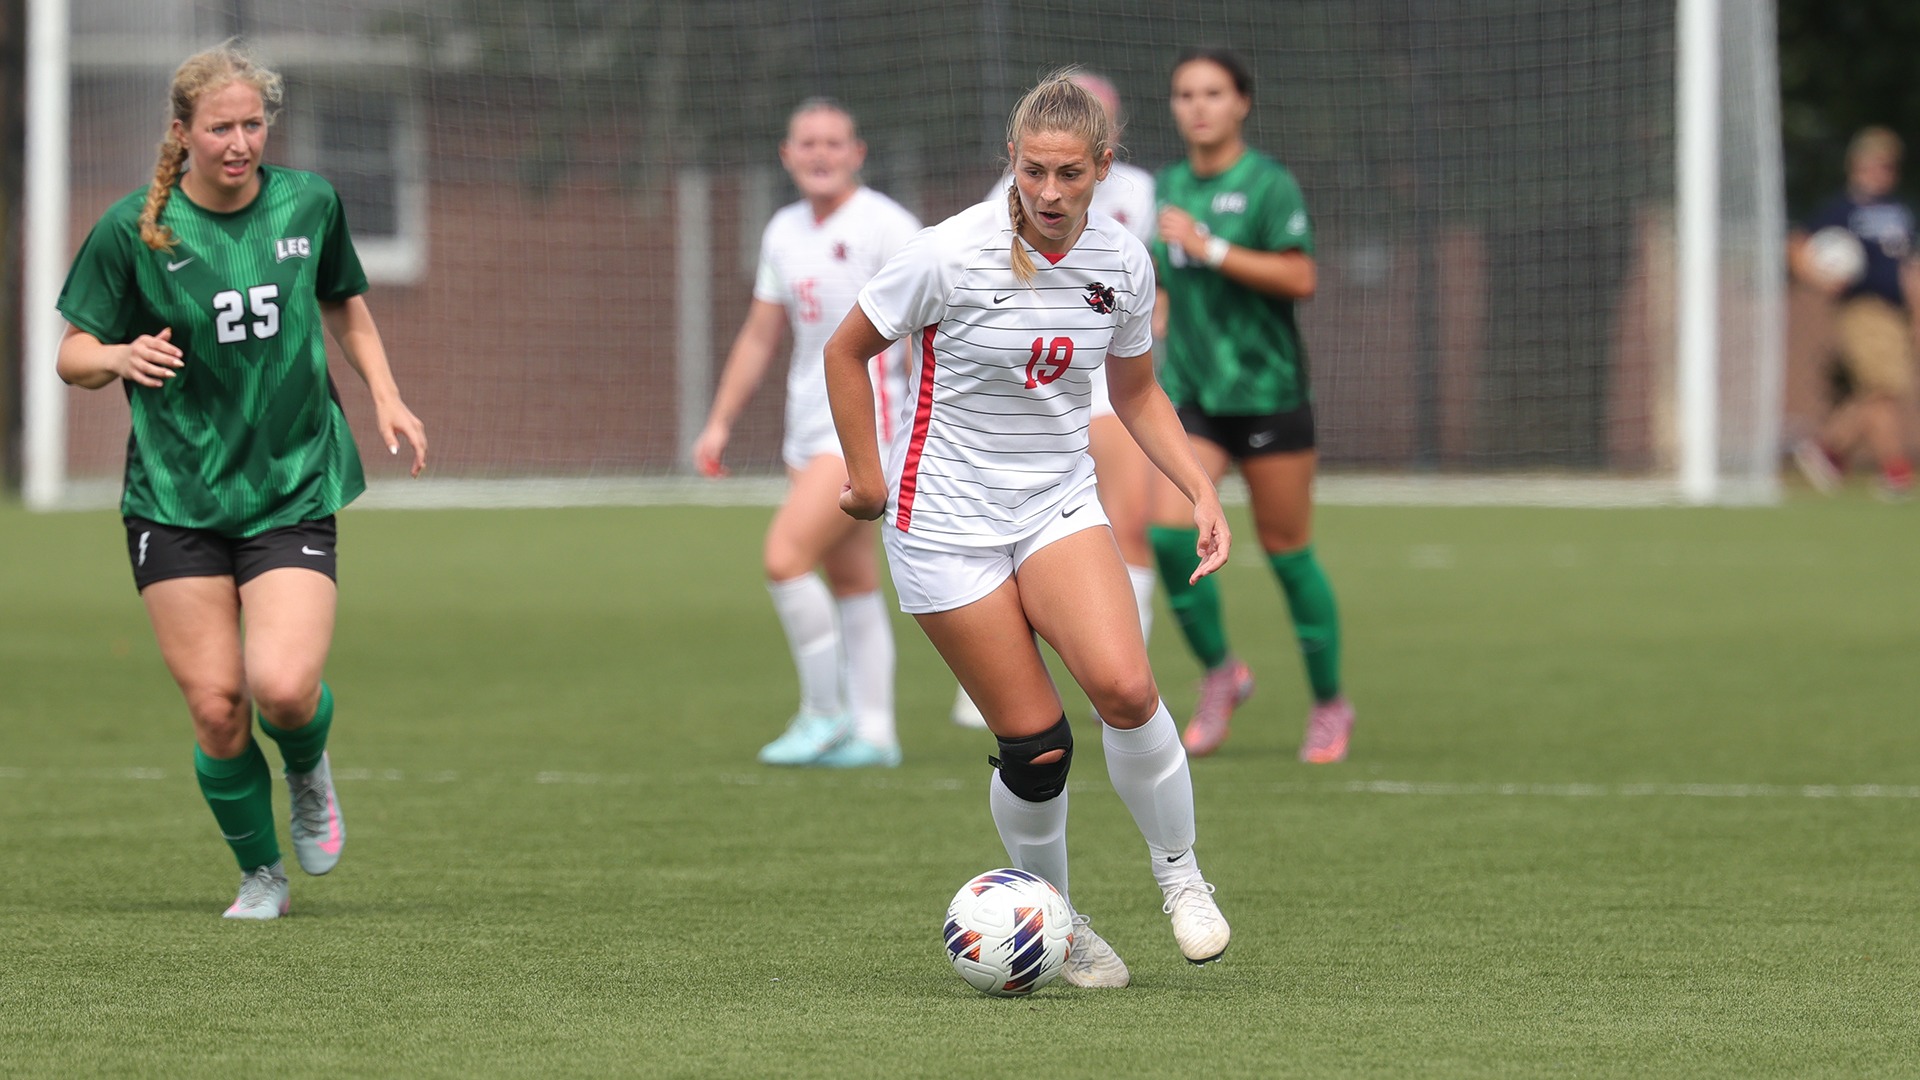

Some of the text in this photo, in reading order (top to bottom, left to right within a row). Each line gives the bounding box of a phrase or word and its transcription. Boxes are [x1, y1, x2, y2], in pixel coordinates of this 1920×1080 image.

[275, 236, 310, 262] LEC
[212, 283, 280, 344] 25
[1024, 336, 1074, 389] 19
